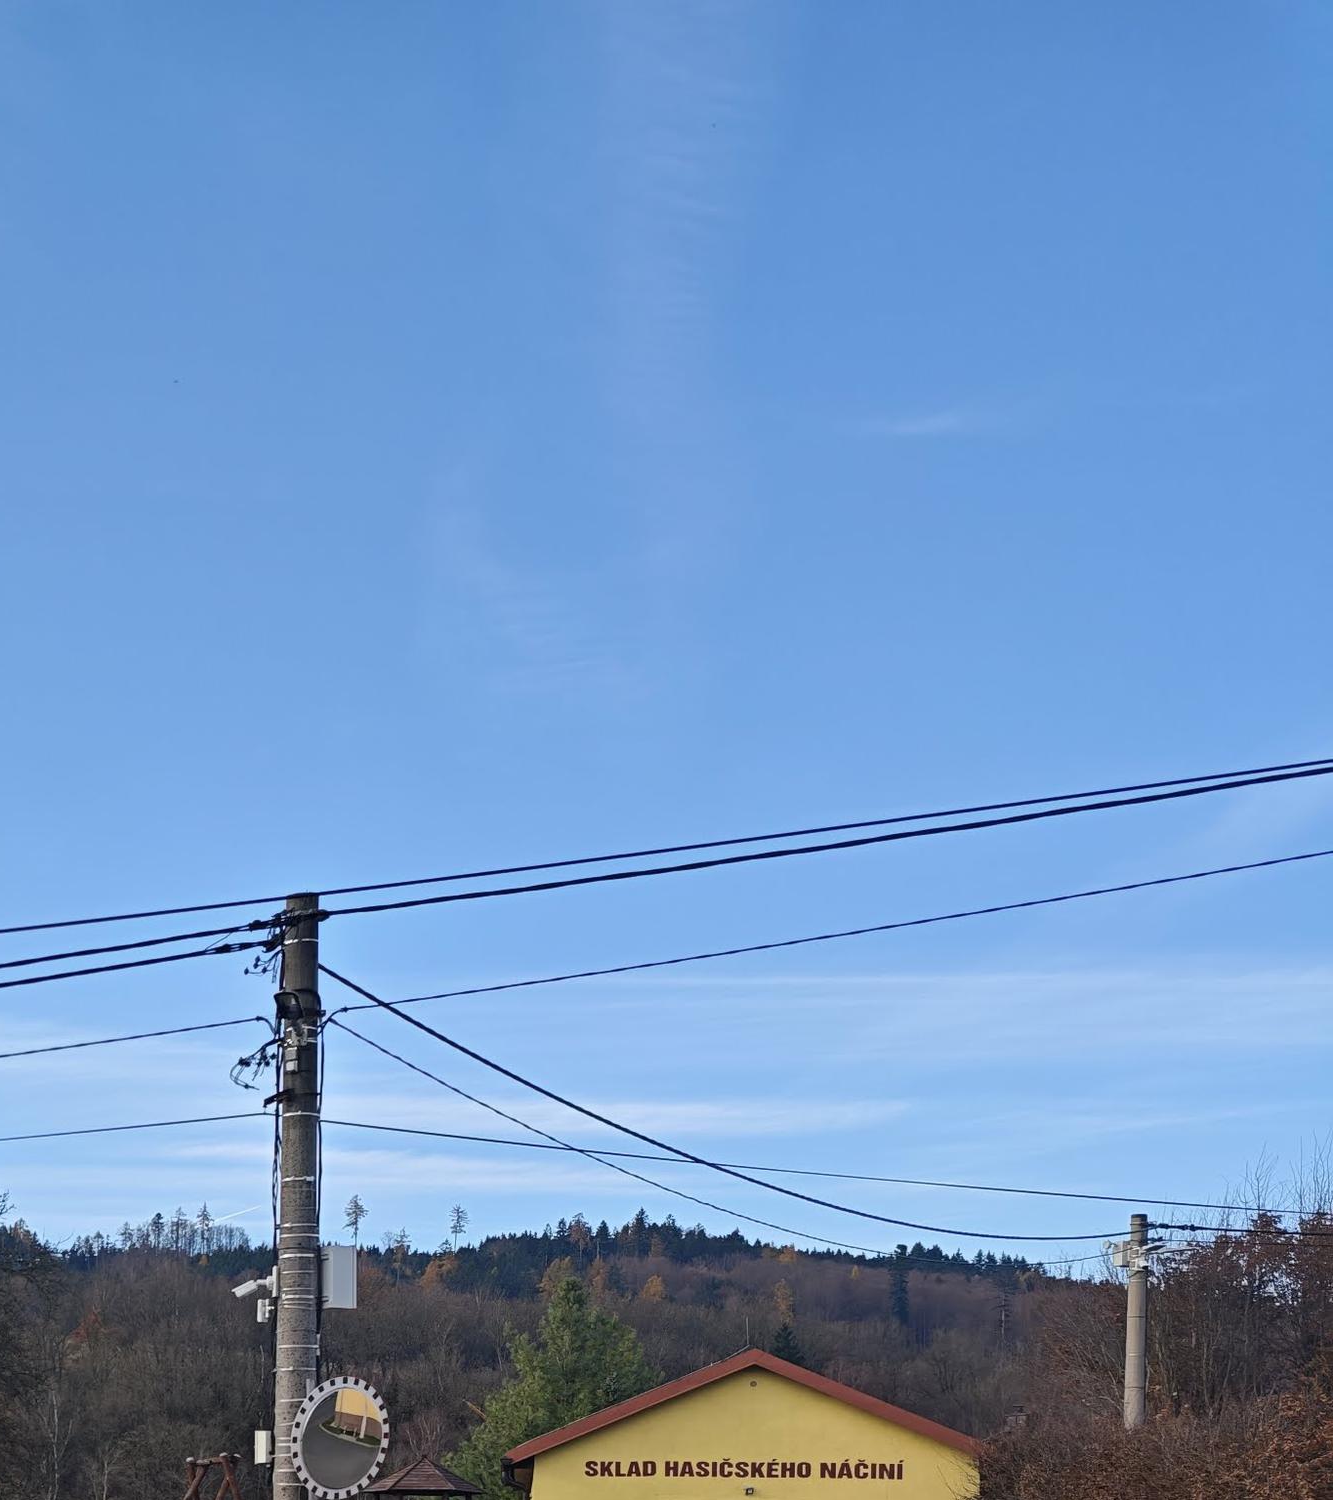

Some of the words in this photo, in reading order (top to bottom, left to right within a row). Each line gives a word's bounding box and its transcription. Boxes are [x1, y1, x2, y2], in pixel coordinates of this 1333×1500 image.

[584, 1460, 657, 1478] SKLAD
[664, 1458, 811, 1479] HASIČSKÉHO
[819, 1459, 905, 1481] NÁČINÍ
